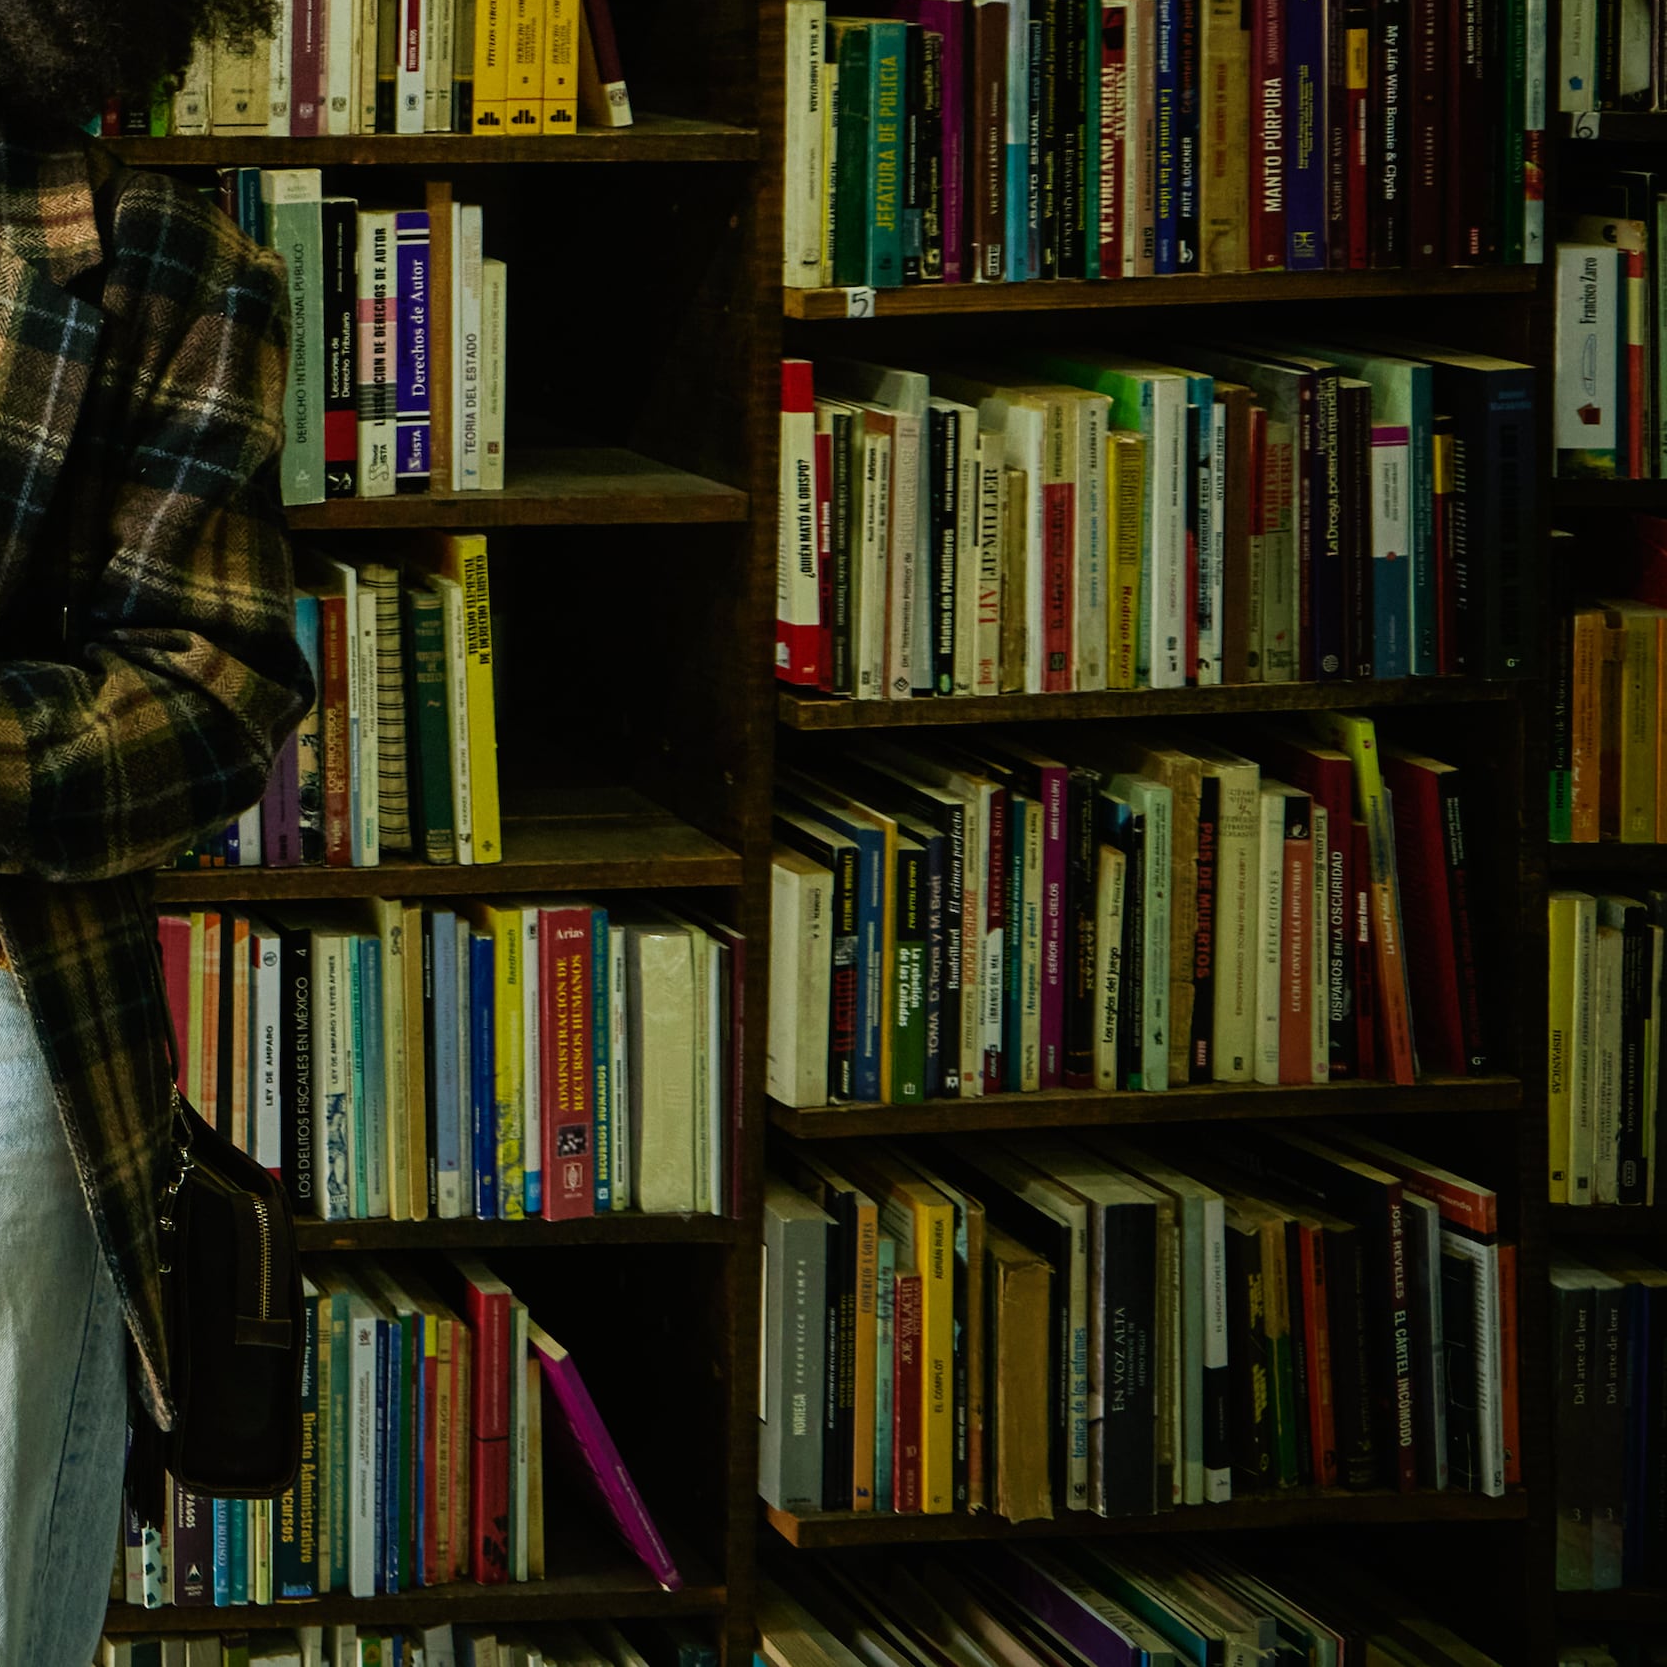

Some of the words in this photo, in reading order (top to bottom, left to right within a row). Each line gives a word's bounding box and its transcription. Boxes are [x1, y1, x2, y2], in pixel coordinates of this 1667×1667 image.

[879, 56, 898, 116] POLICIA
[878, 124, 897, 142] DE
[1260, 78, 1281, 150] PÚRPURA
[1576, 112, 1593, 139] 6
[876, 149, 896, 231] JEFATURA
[1264, 156, 1281, 212] MANTO
[410, 260, 424, 302] Autor
[411, 308, 423, 324] de
[851, 292, 868, 317] 5
[411, 328, 425, 396] Derechos
[413, 430, 421, 457] SISTA
[798, 460, 810, 499] OBISPO?
[798, 515, 811, 541] MATÓ
[799, 503, 811, 512] AL
[799, 545, 815, 578] ¿QUIÉN
[558, 958, 567, 978] DE
[293, 977, 308, 1030] MÉXICO
[570, 954, 582, 1028] HUMANOS
[297, 1034, 308, 1049] EN
[555, 984, 569, 1111] ADMINISTRACIÓN
[297, 1055, 309, 1113] FISCALES
[572, 1032, 585, 1110] RECURSOS
[298, 1117, 310, 1169] DELITOS
[299, 1173, 310, 1198] LOS
[1394, 1310, 1406, 1326] EL
[1395, 1329, 1409, 1375] CÁRTEL
[1397, 1378, 1412, 1446] INCÓMODO
